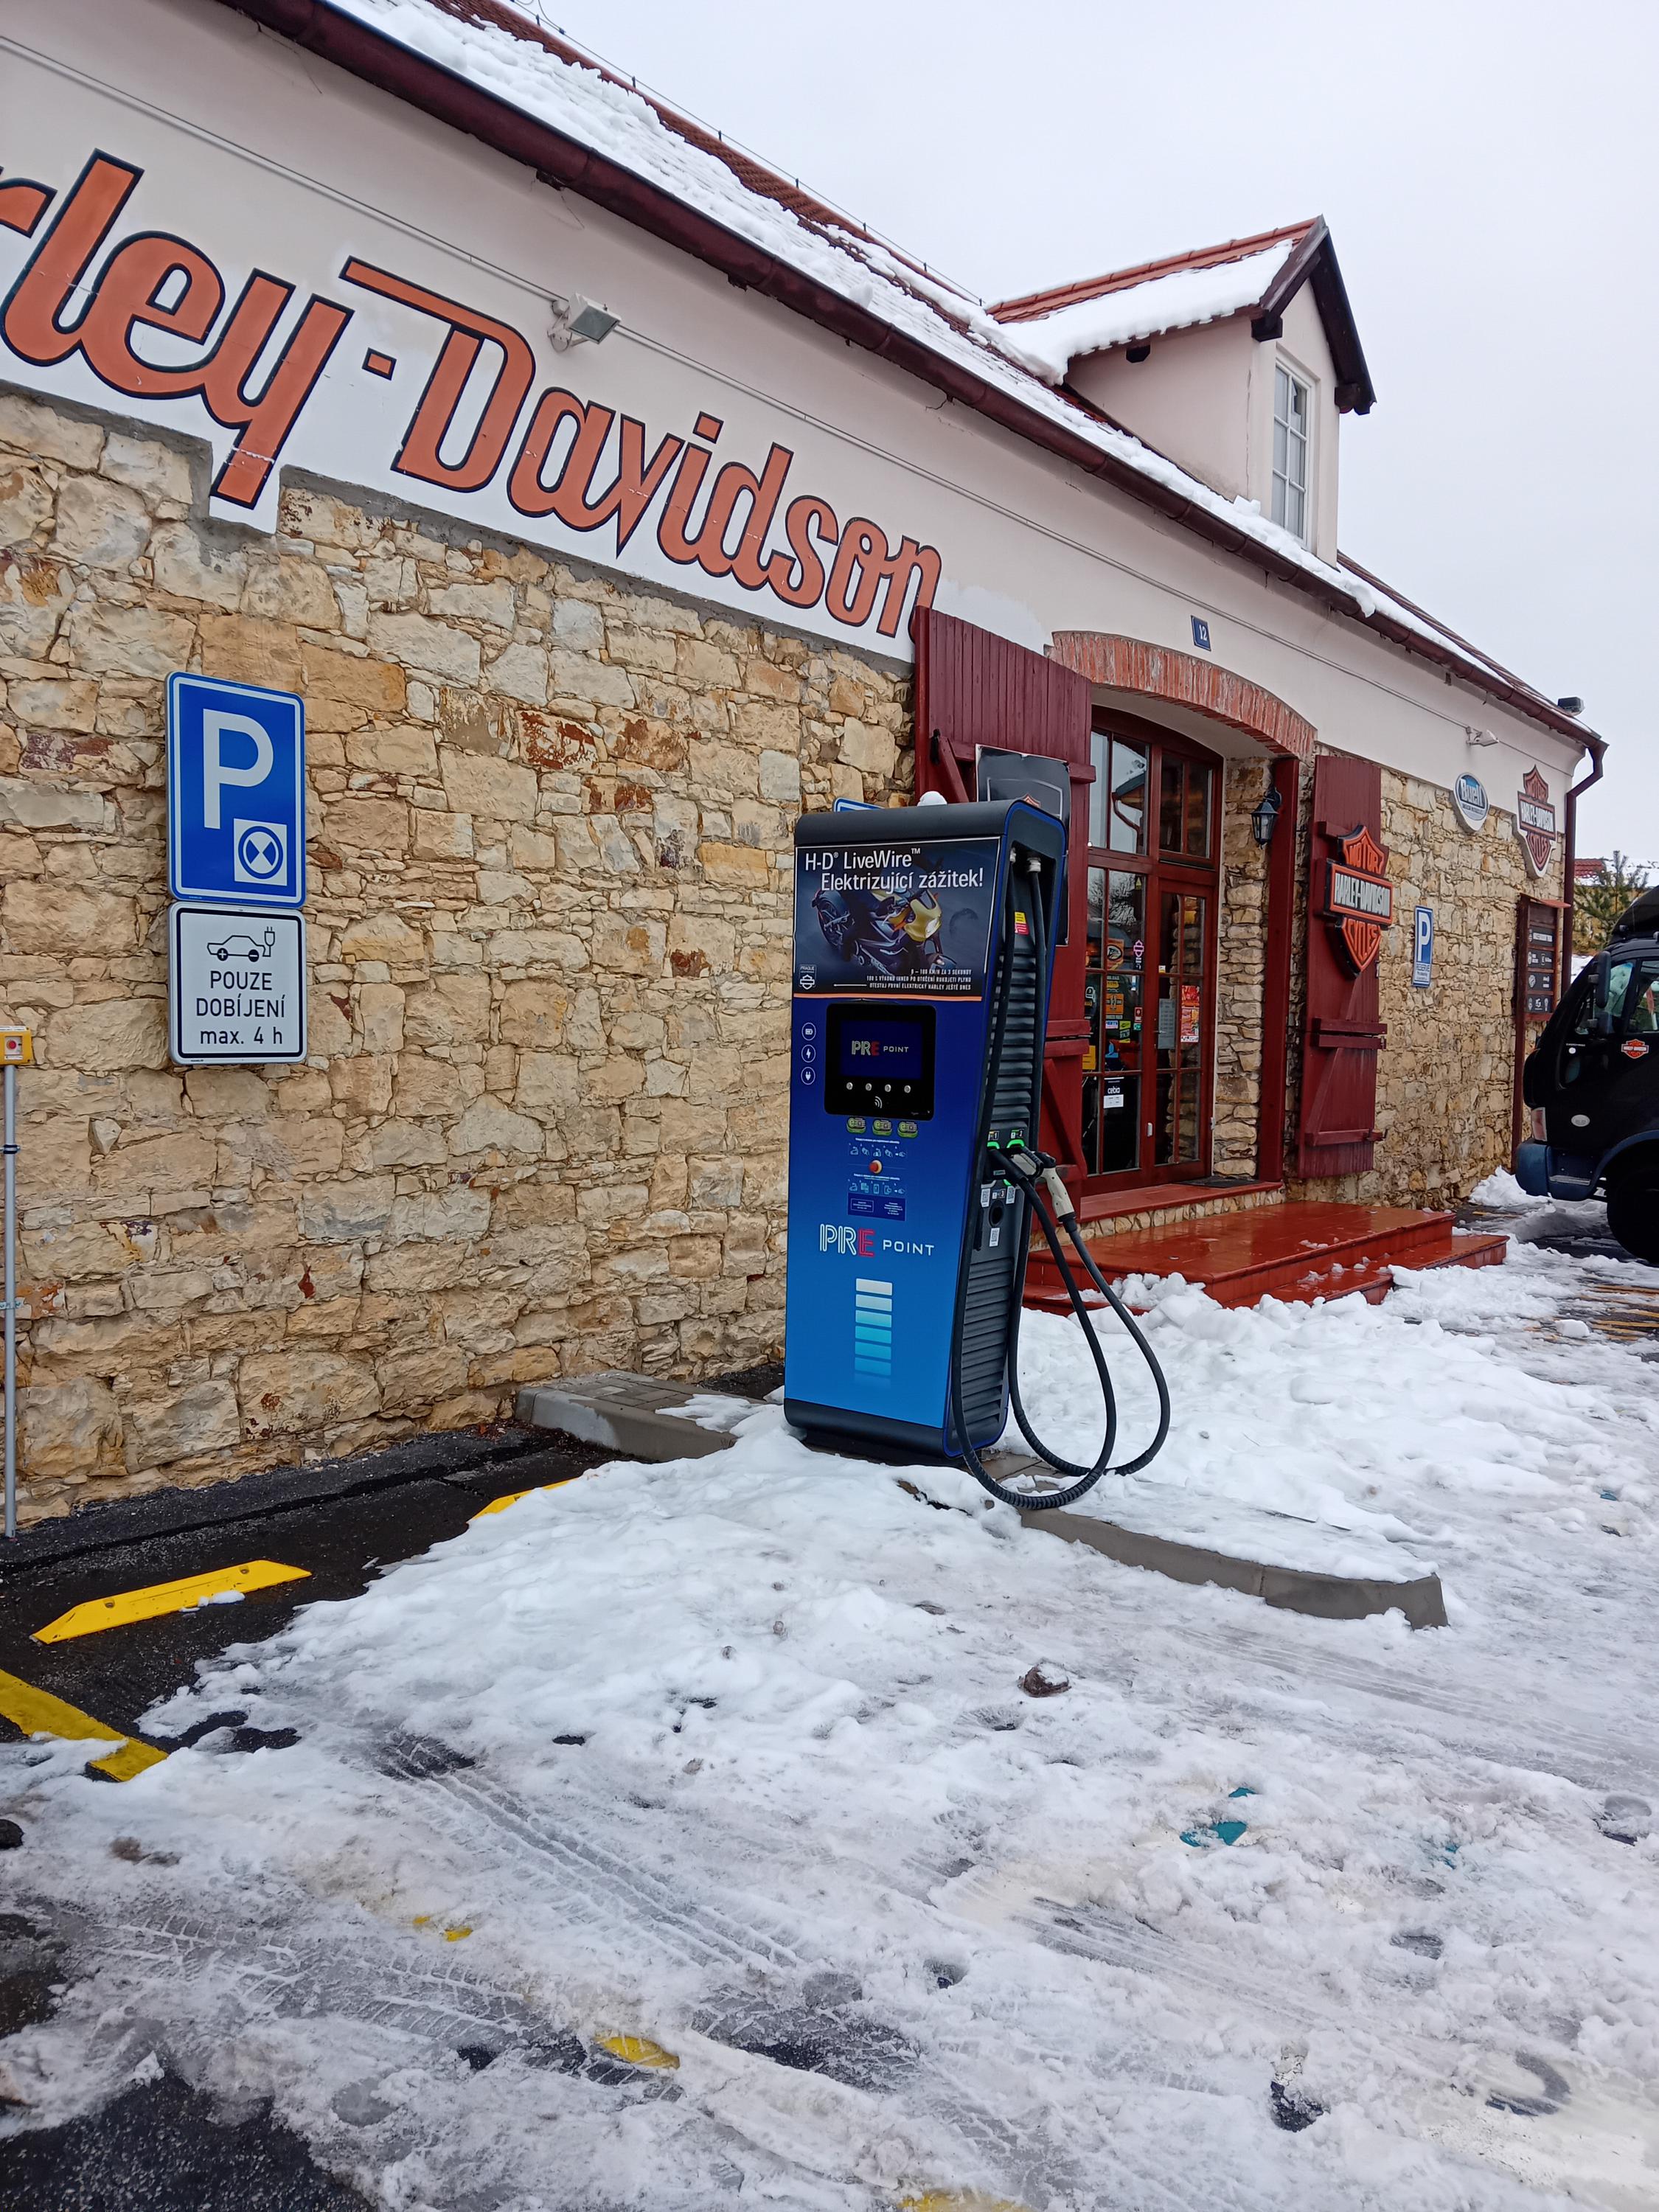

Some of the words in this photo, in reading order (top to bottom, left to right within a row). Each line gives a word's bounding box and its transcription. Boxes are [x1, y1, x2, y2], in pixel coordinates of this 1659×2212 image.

[1199, 624, 1208, 641] 12
[204, 709, 274, 830] P
[1347, 836, 1383, 873] MOTOR
[821, 871, 914, 894] Elektrizující
[919, 868, 984, 889] zážitek!
[1334, 872, 1391, 917] HARLEY-DAVIDSON
[1347, 919, 1379, 961] CYCLES
[1417, 911, 1431, 962] P
[210, 970, 273, 991] POUZE
[196, 993, 285, 1018] DOBÍJENÍ
[200, 1030, 244, 1045] max.
[253, 1026, 264, 1045] 4
[273, 1026, 283, 1045] h
[851, 1040, 880, 1057] PRE
[883, 1046, 909, 1054] POINT
[819, 1223, 875, 1258] PRE
[883, 1239, 935, 1256] POINT
